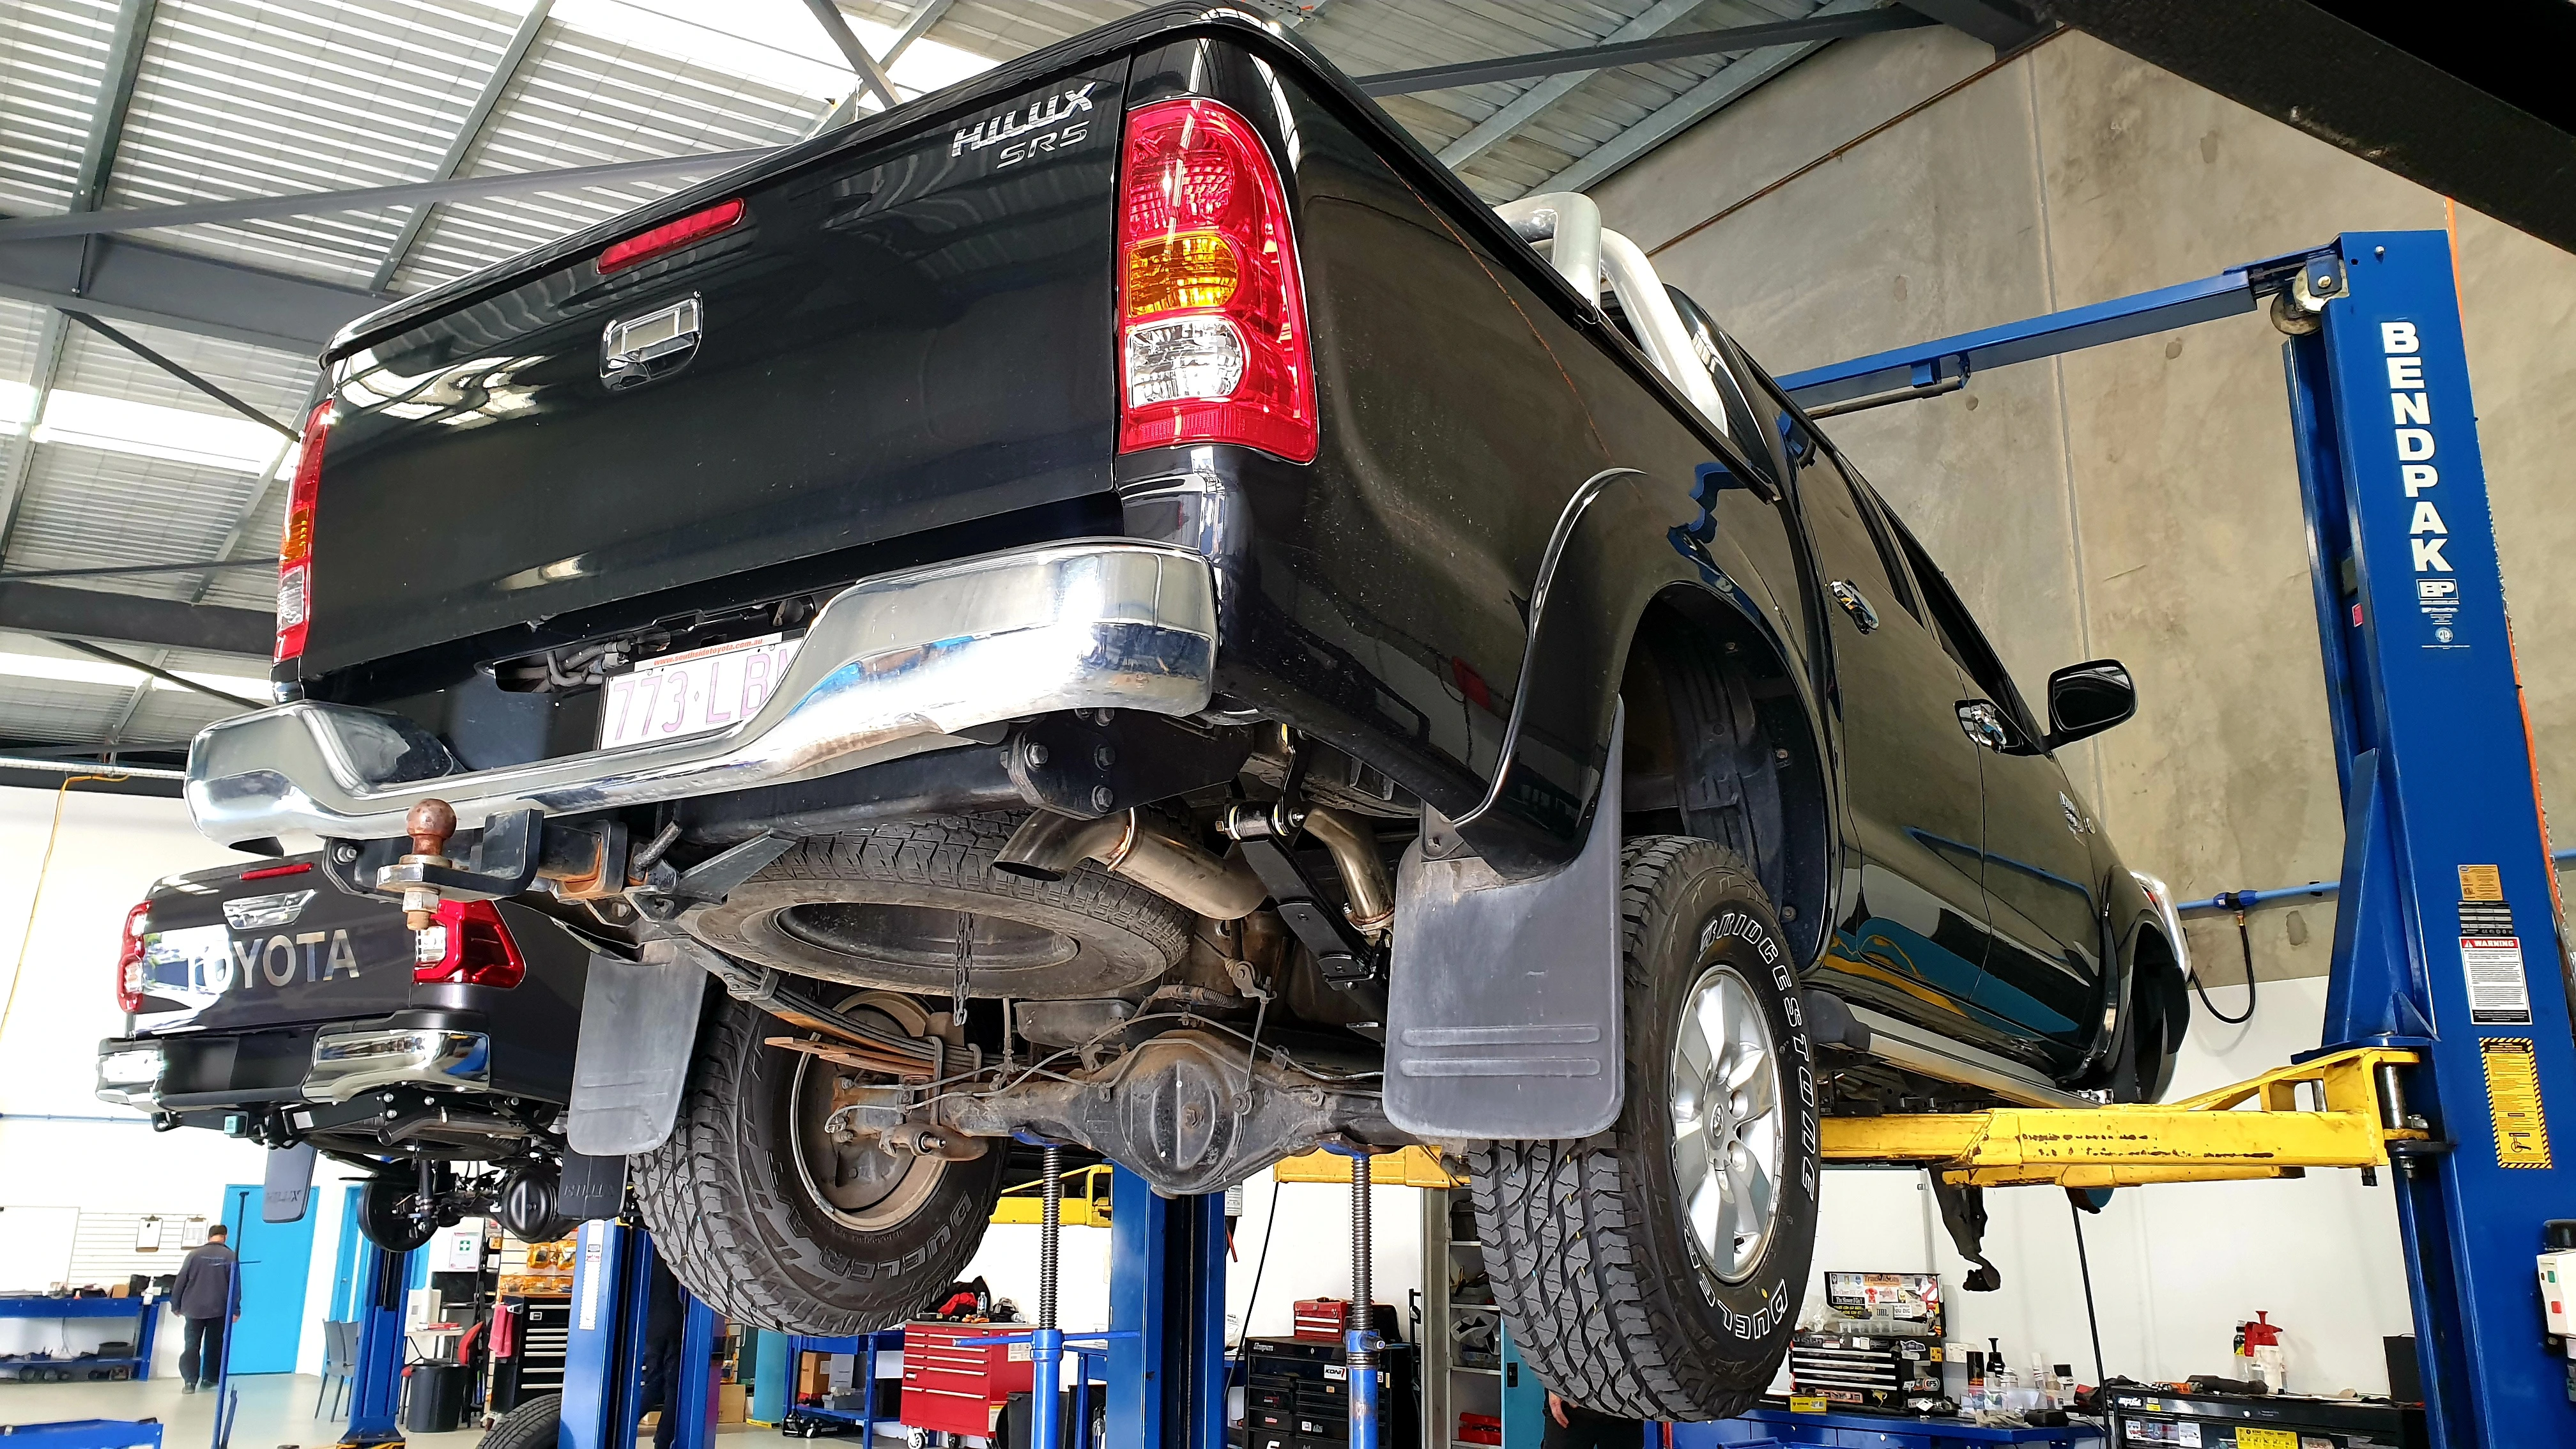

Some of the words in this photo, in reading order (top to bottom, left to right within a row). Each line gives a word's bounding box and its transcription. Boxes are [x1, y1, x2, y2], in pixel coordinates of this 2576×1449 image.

[951, 81, 1096, 157] HILUX
[997, 120, 1090, 169] SR5
[2380, 321, 2454, 572] BENDPAK
[2419, 581, 2455, 597] BP
[1698, 912, 1816, 1201] BRIDGESTONE
